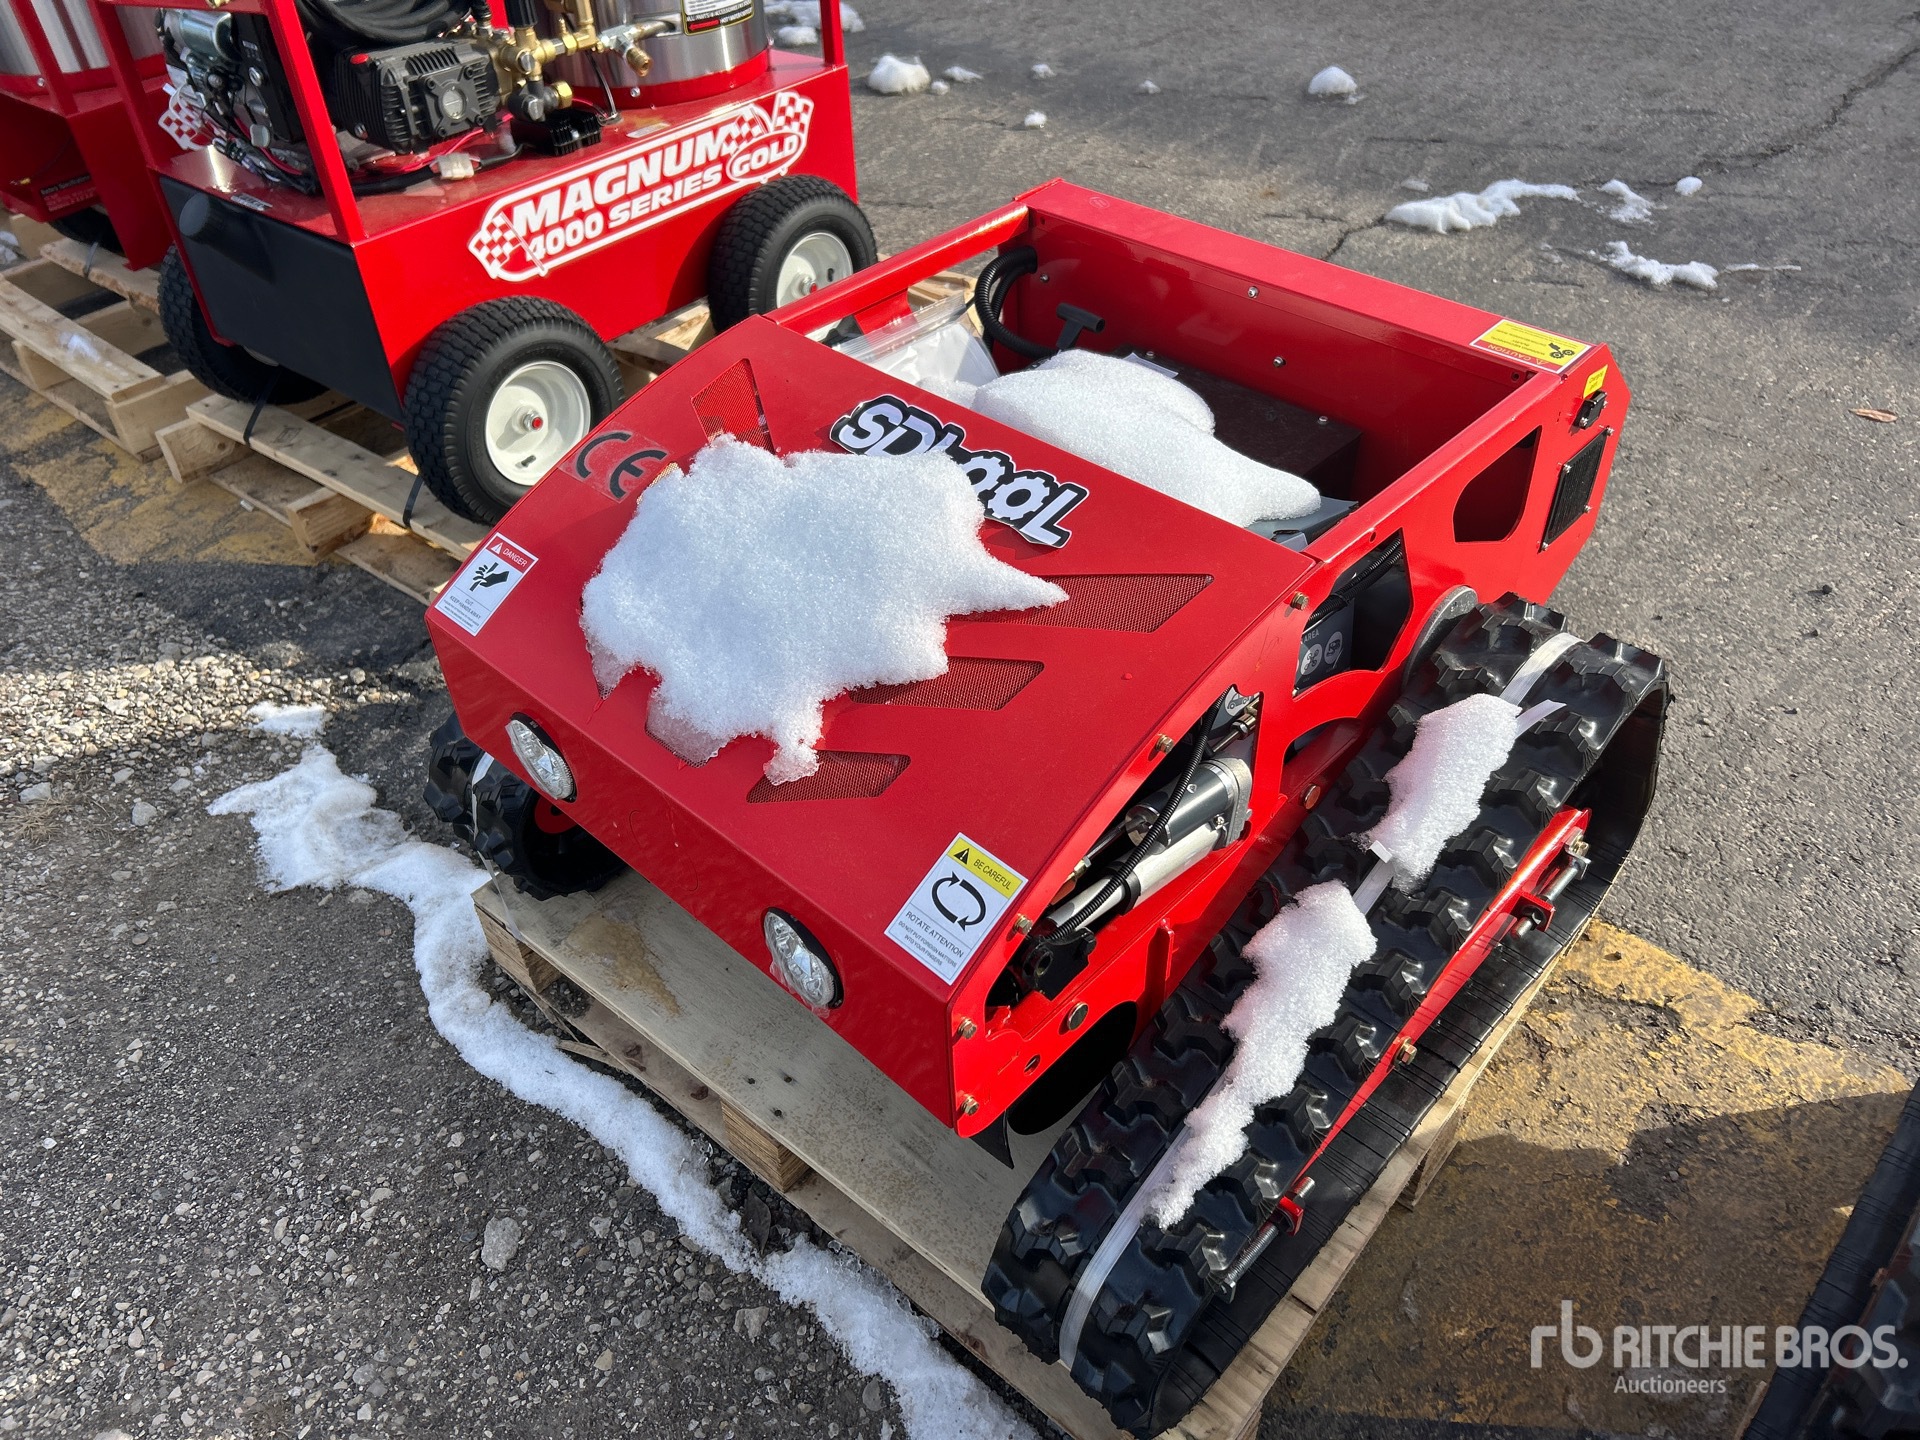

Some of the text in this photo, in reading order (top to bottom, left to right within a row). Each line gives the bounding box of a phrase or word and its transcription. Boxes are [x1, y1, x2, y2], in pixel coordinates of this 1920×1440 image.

[732, 134, 799, 176] GOLD
[511, 124, 734, 237] MAGNUM
[525, 164, 722, 261] 4000 SERIES
[1486, 344, 1532, 360] CAUTION
[502, 548, 527, 566] DANGER
[449, 596, 459, 604] KEEP
[1304, 629, 1320, 643] AREA
[973, 859, 1012, 889] BE CAREFUL
[904, 925, 913, 933] NOT
[912, 931, 921, 939] PUT
[937, 951, 956, 967] MATTERS
[905, 911, 963, 958] ROTATE ATTENTION
[904, 935, 942, 965] INTO YOUR FINGERS
